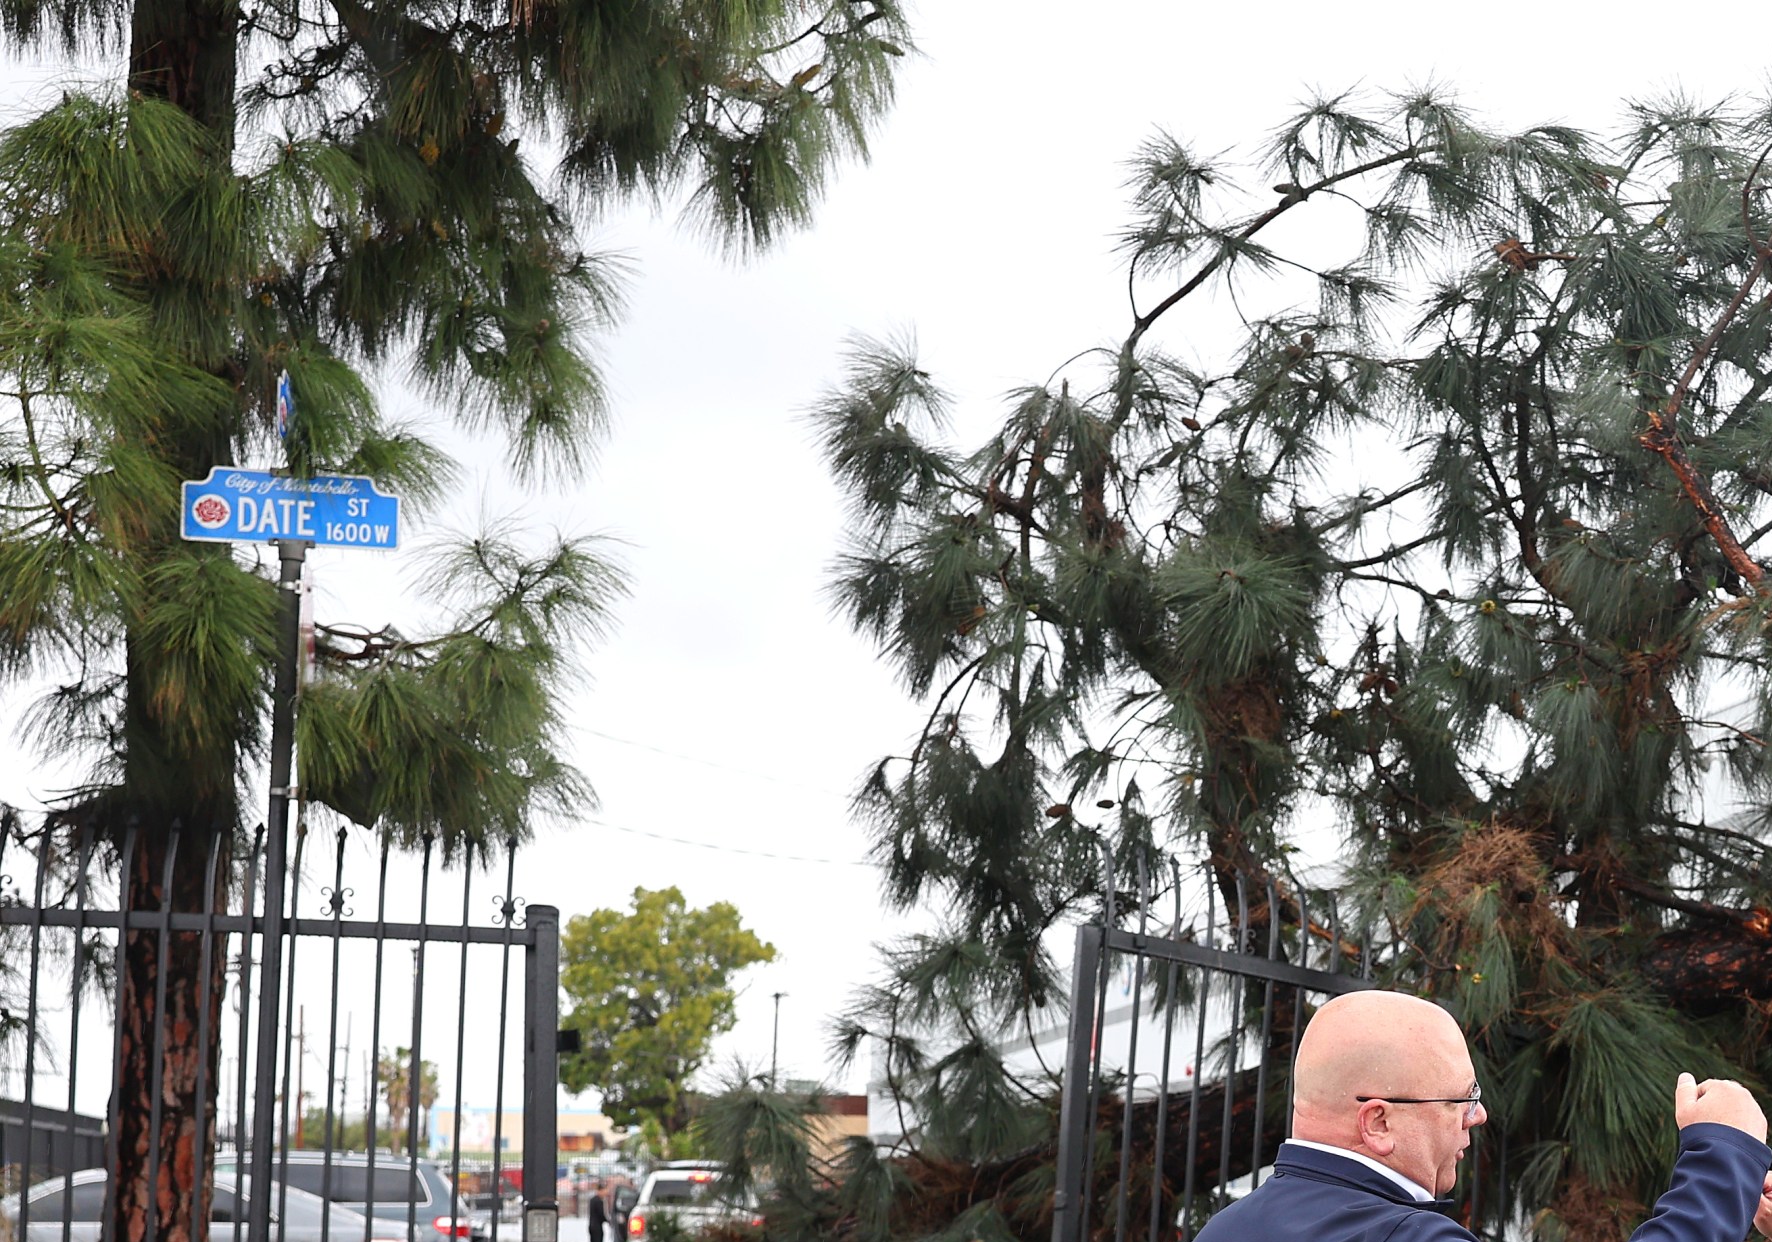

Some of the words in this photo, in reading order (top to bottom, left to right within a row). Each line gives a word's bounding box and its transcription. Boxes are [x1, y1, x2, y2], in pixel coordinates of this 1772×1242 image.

[225, 473, 257, 492] City
[257, 477, 280, 495] of
[237, 497, 316, 536] DATE
[347, 498, 370, 517] ST
[326, 523, 371, 543] 1600
[374, 525, 390, 544] W
